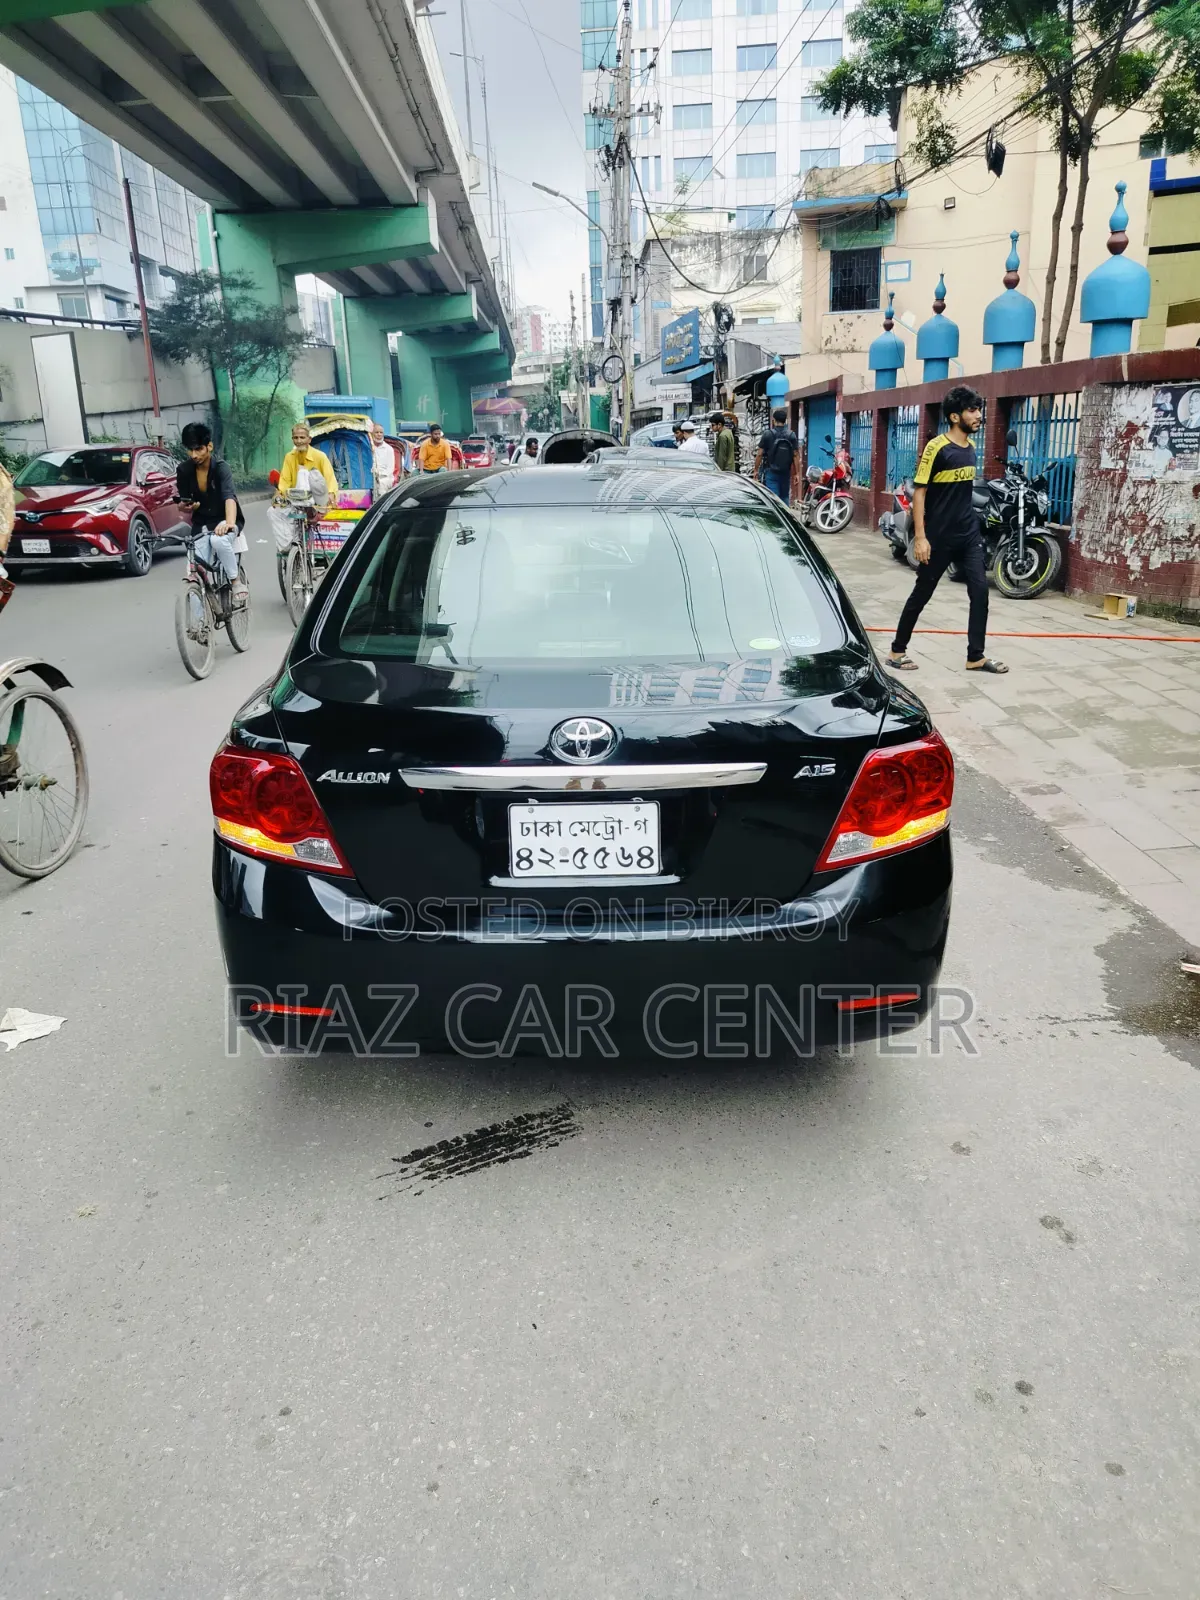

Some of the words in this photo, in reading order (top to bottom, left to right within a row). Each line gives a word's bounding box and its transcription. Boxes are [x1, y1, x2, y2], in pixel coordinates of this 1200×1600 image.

[316, 769, 391, 784] ALLION
[793, 763, 836, 779] A15
[519, 819, 562, 837] ঢাকা
[515, 845, 655, 871] ৪২-৫৫৬৪
